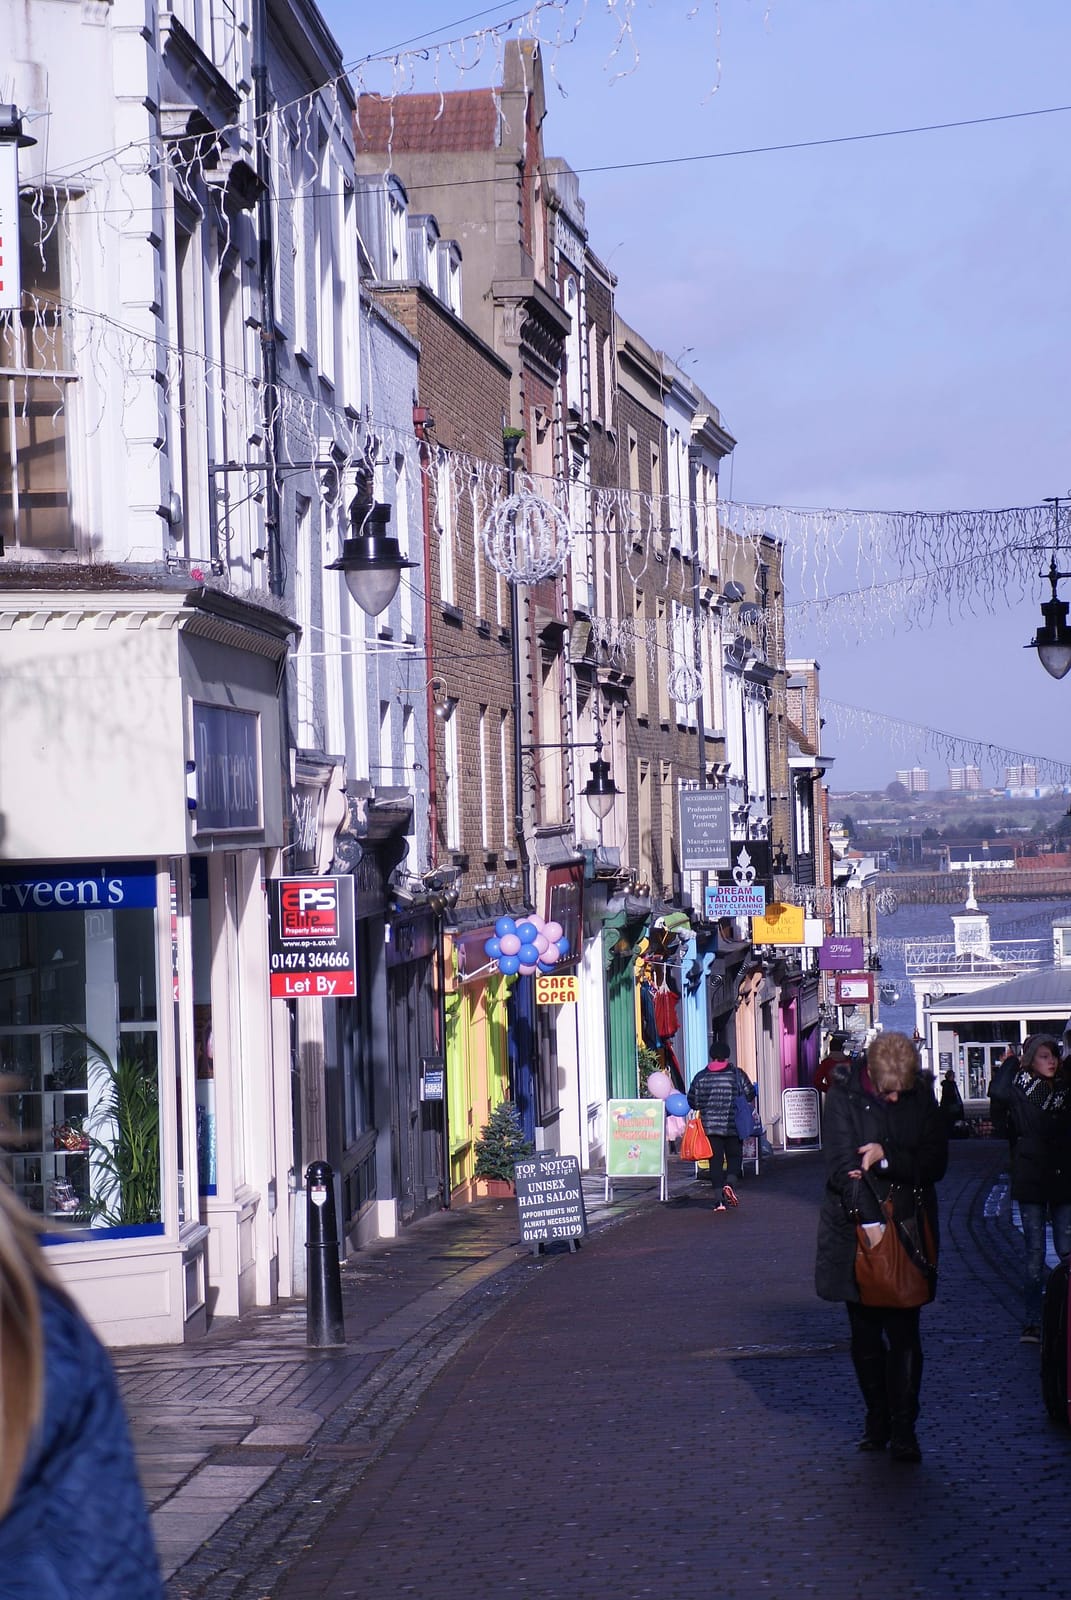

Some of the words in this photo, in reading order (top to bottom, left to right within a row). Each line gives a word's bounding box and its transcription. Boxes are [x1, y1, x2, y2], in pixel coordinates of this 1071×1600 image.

[717, 887, 753, 895] DREAM
[282, 888, 336, 911] EPS
[708, 895, 763, 903] TAILORING
[285, 911, 321, 928] Elite
[285, 927, 309, 935] Property
[310, 926, 334, 934] Services
[271, 953, 306, 969] 01474
[308, 951, 350, 968] 364666
[285, 977, 311, 993] Let
[316, 975, 337, 995] By
[538, 977, 574, 989] CAFE
[538, 991, 576, 1003] OPEN
[516, 1163, 536, 1174] TOP
[540, 1159, 577, 1172] NOTCH
[545, 1168, 573, 1176] design
[528, 1178, 566, 1193] UNISEX
[518, 1194, 545, 1207] HAIR
[546, 1189, 580, 1203] SALON
[522, 1207, 565, 1219] APPOINTMENTS
[566, 1205, 579, 1213] NOT
[523, 1219, 546, 1229] ALWAYS
[547, 1215, 581, 1226] NECESSARY
[523, 1228, 548, 1241] 01474
[552, 1224, 582, 1238] 331199
